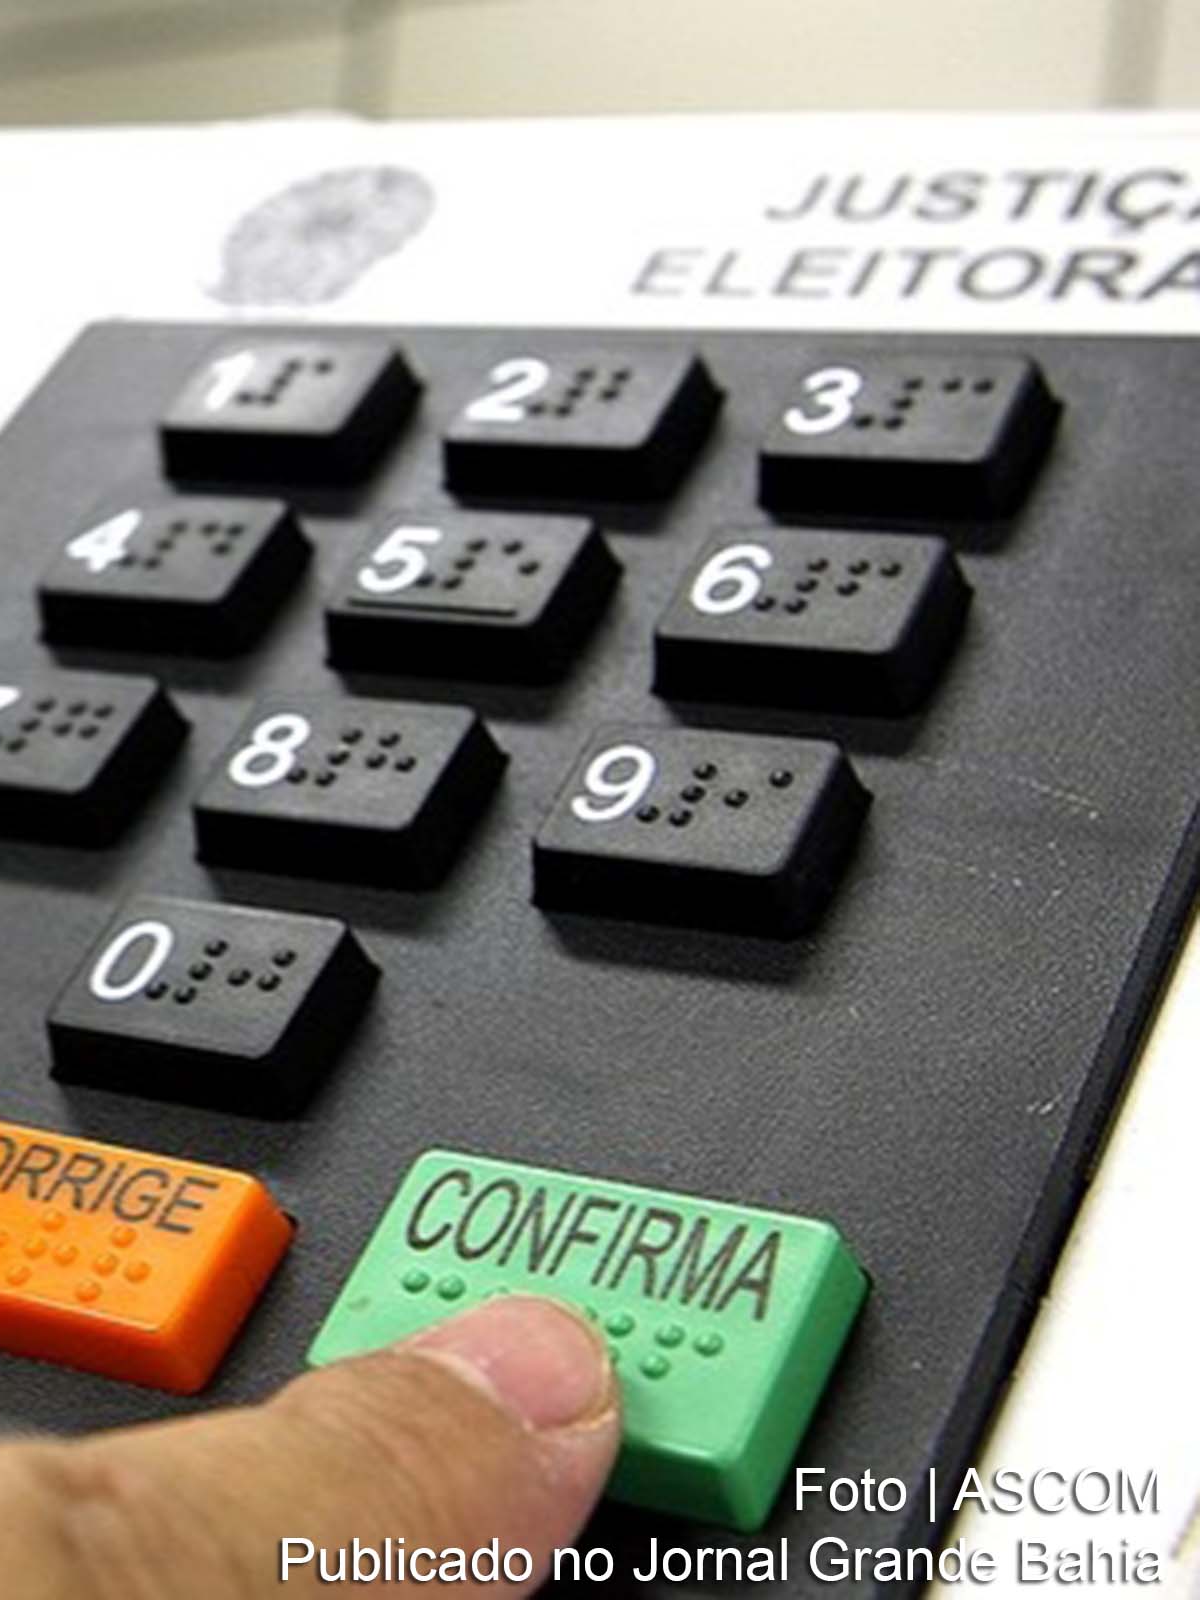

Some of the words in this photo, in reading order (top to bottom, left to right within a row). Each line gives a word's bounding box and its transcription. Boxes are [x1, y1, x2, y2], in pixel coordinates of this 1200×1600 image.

[764, 167, 1200, 236] JUSTIÇ
[201, 351, 257, 409] 1
[464, 358, 550, 421] 2
[784, 367, 860, 434] 3
[66, 509, 141, 572] 4
[358, 526, 442, 593] 5
[691, 543, 773, 614] 6
[228, 713, 311, 786] 8
[571, 744, 657, 822] 9
[89, 920, 174, 1001] 0
[405, 1169, 783, 1321] CONFIRMA
